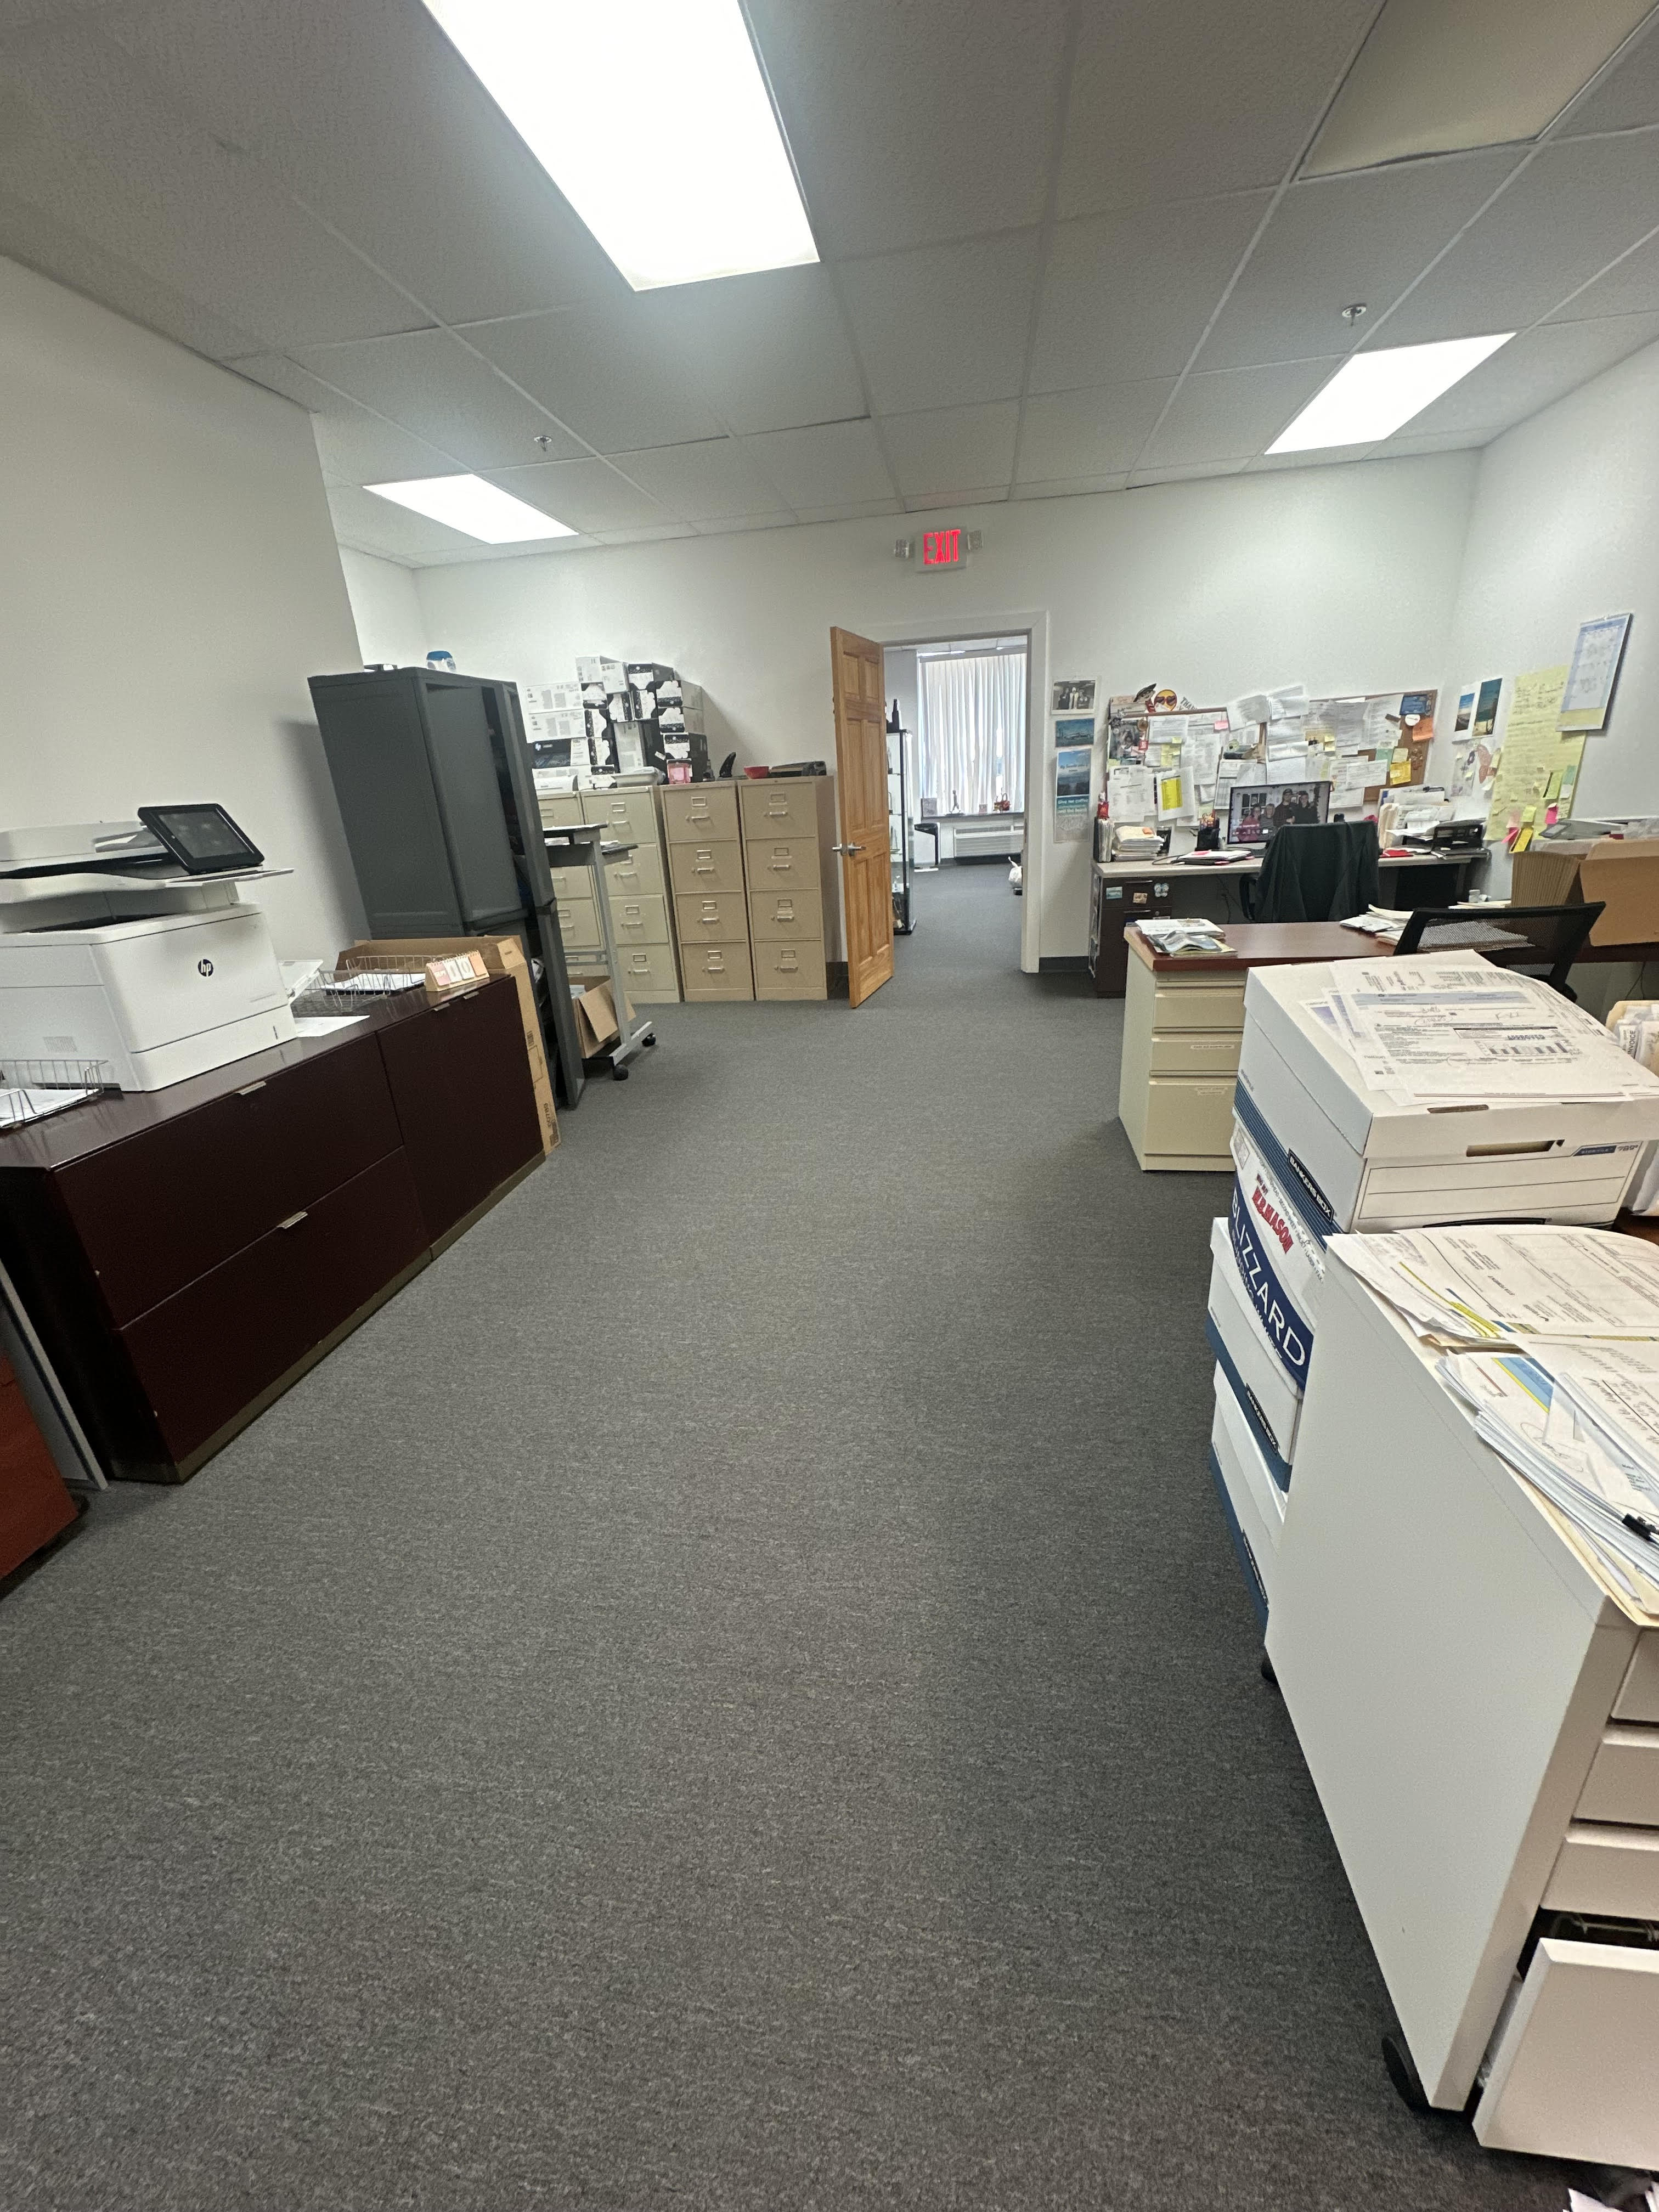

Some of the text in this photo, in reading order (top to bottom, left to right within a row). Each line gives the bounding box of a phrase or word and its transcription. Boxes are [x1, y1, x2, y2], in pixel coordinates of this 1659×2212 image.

[923, 529, 961, 565] EXIT
[1180, 696, 1197, 710] THA
[200, 959, 212, 977] hp
[1628, 1030, 1636, 1054] INVOICE
[1289, 1155, 1331, 1216] BANKERS BOX
[1232, 1189, 1305, 1366] BLIZZARD
